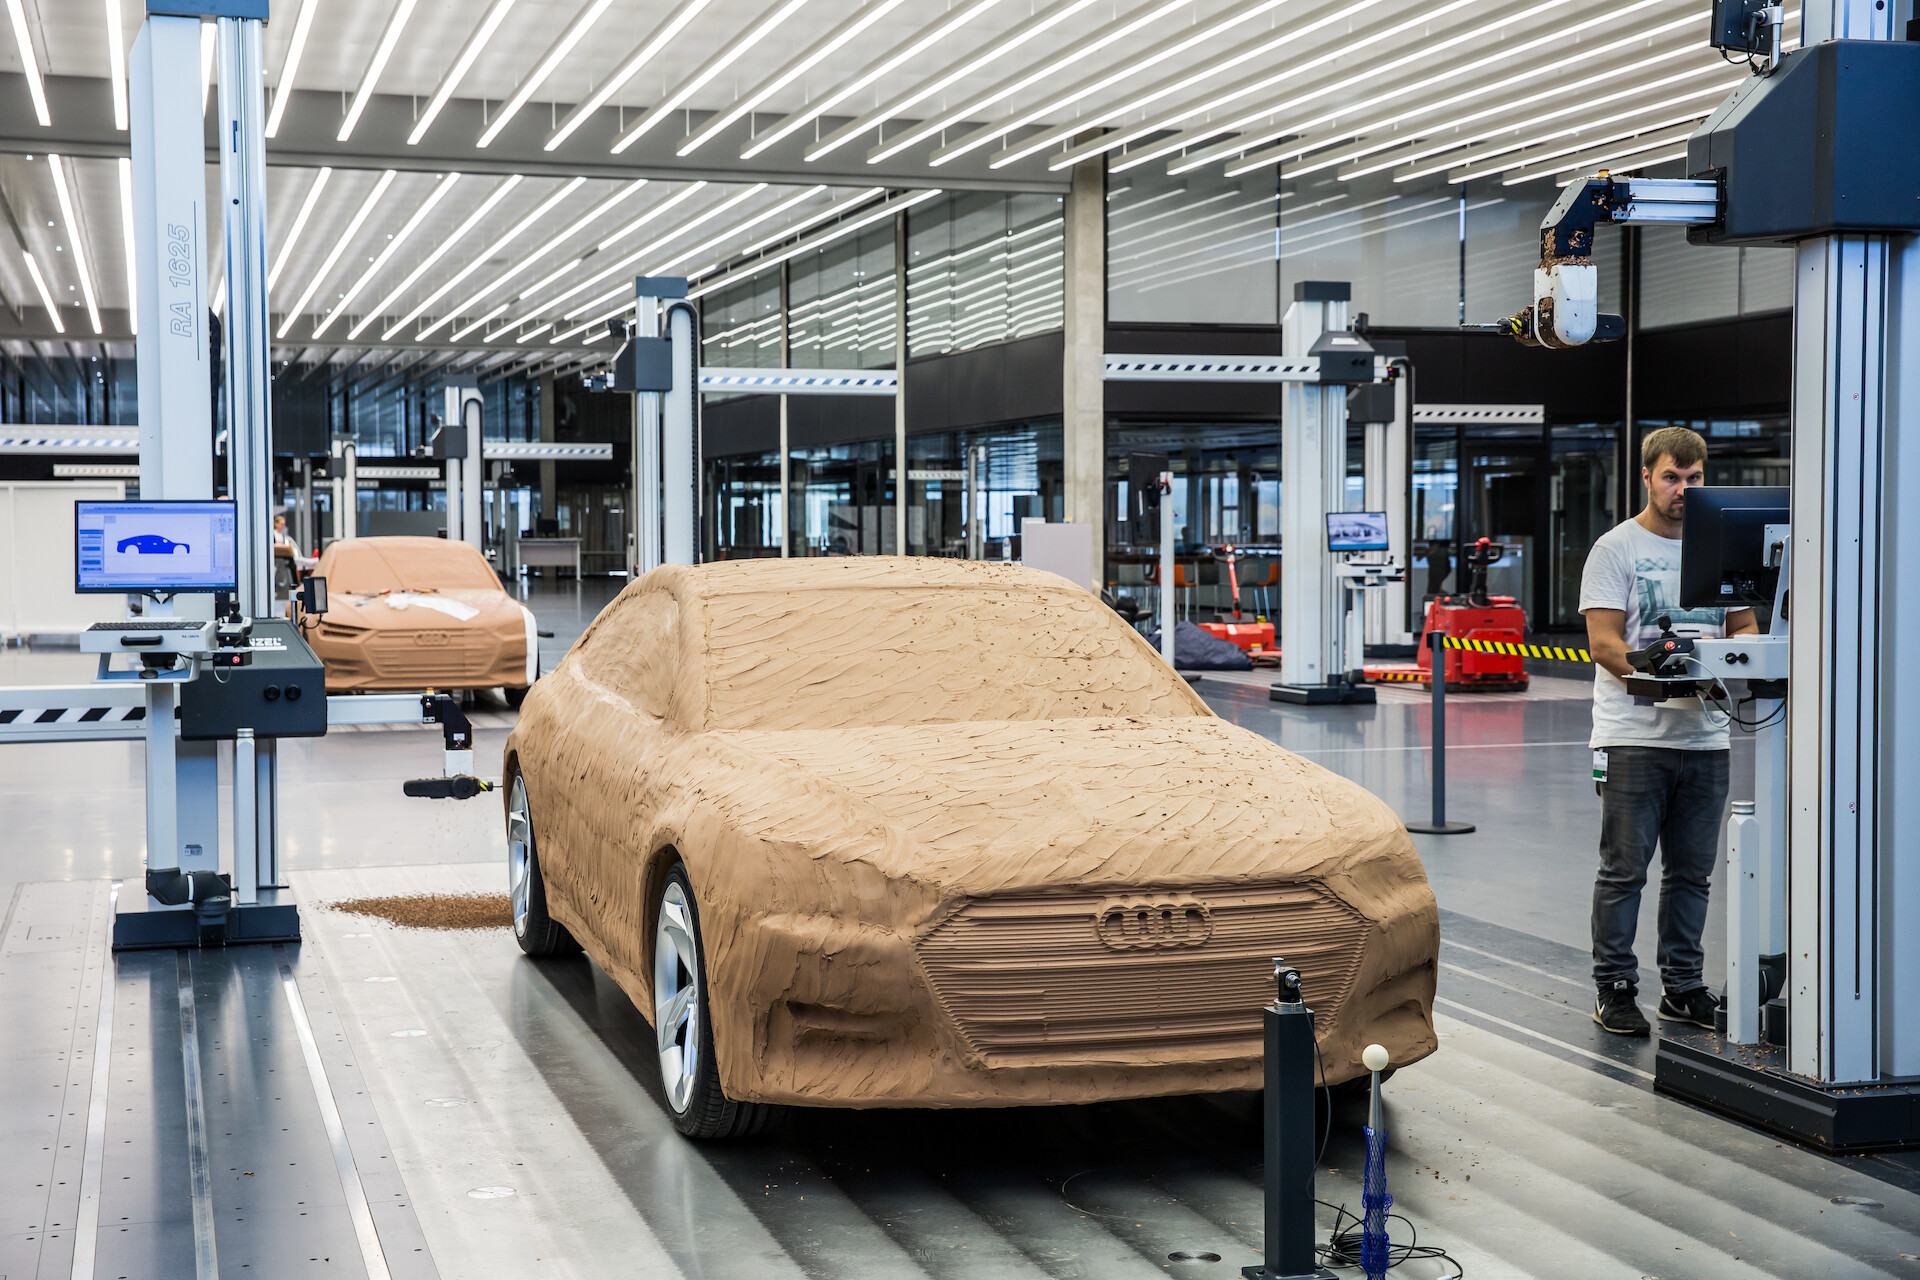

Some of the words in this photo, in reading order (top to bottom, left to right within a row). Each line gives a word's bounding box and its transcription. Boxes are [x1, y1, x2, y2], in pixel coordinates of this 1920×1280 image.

[167, 223, 191, 288] 1625
[170, 302, 192, 338] RA
[248, 637, 282, 646] NZEL
